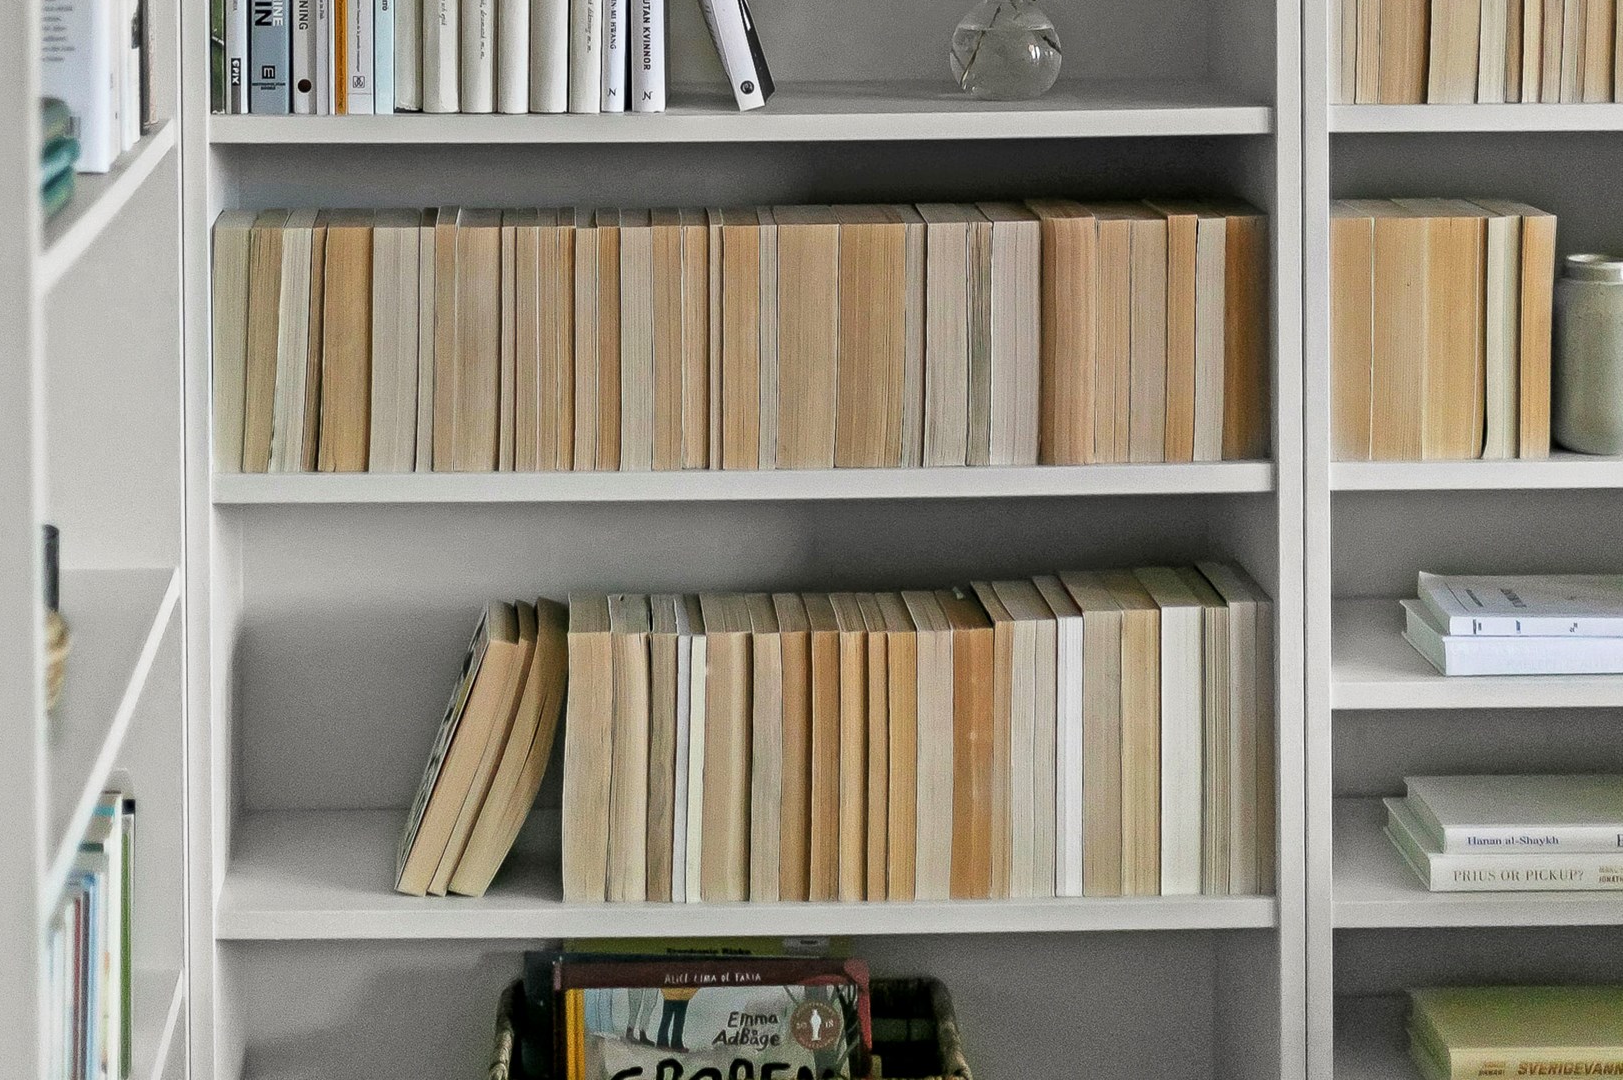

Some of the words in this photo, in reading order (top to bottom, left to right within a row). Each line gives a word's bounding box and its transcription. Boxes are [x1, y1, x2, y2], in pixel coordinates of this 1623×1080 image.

[609, 22, 617, 50] HWANG
[643, 26, 651, 70] KVINNOR
[1467, 836, 1502, 846] Hanan
[1505, 836, 1559, 847] al-Shaykh
[1453, 870, 1496, 882] PRIUS
[1501, 870, 1520, 882] OR
[1526, 870, 1584, 882] PICKUP?
[664, 972, 689, 984] ALICE
[727, 1010, 779, 1028] Emma
[711, 1028, 781, 1052] AdBåge
